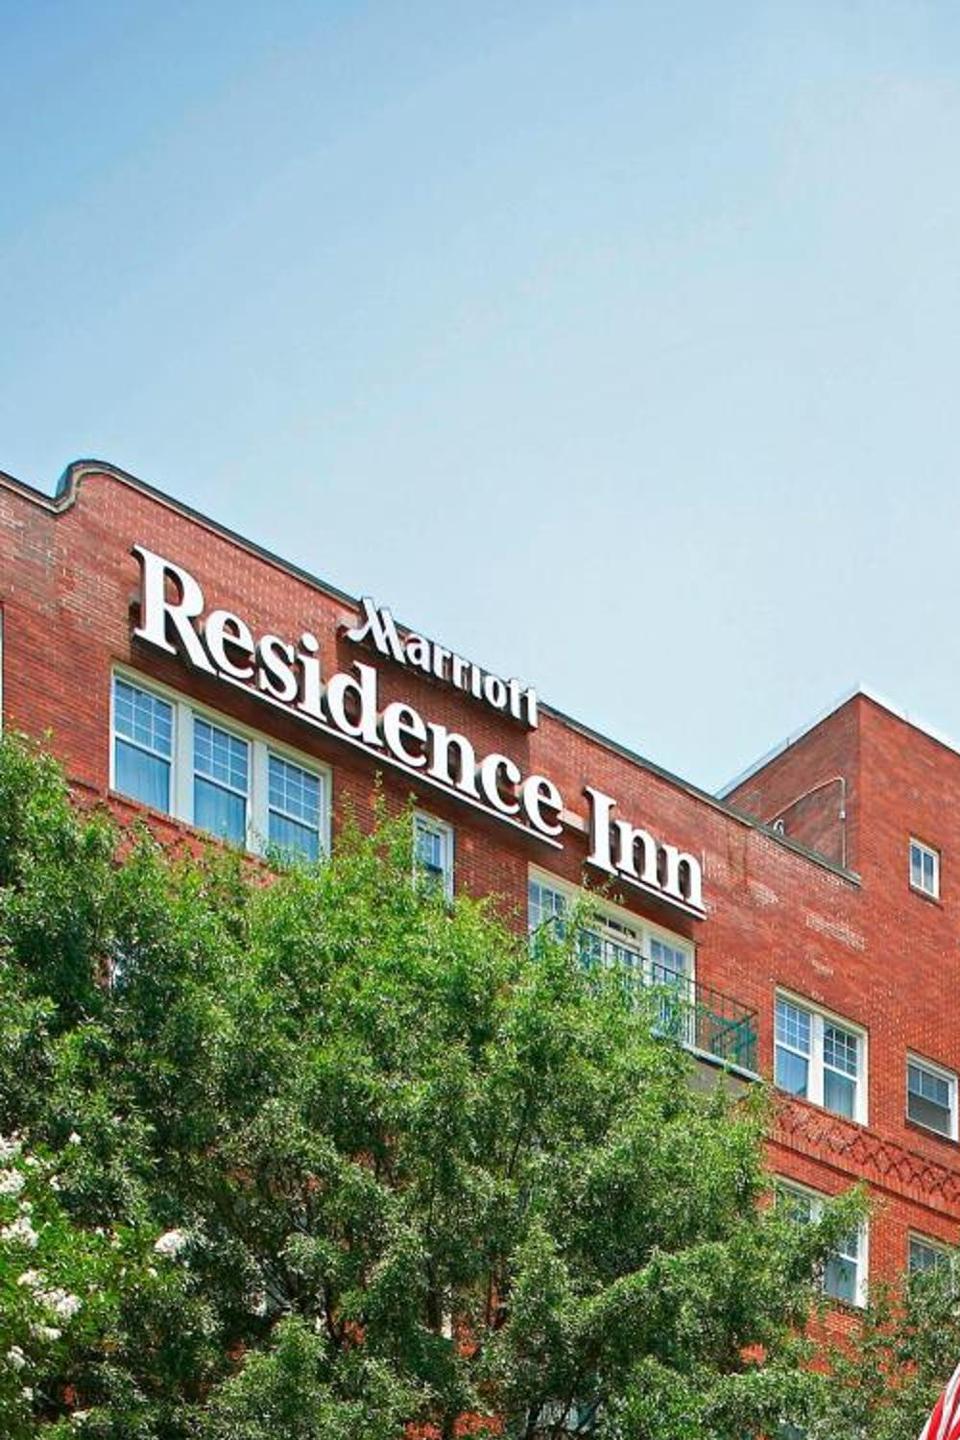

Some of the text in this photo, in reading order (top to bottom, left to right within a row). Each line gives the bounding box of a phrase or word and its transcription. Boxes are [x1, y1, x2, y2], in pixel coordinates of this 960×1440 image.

[134, 544, 706, 912] Residence Inn
[346, 596, 538, 729] Marriott
